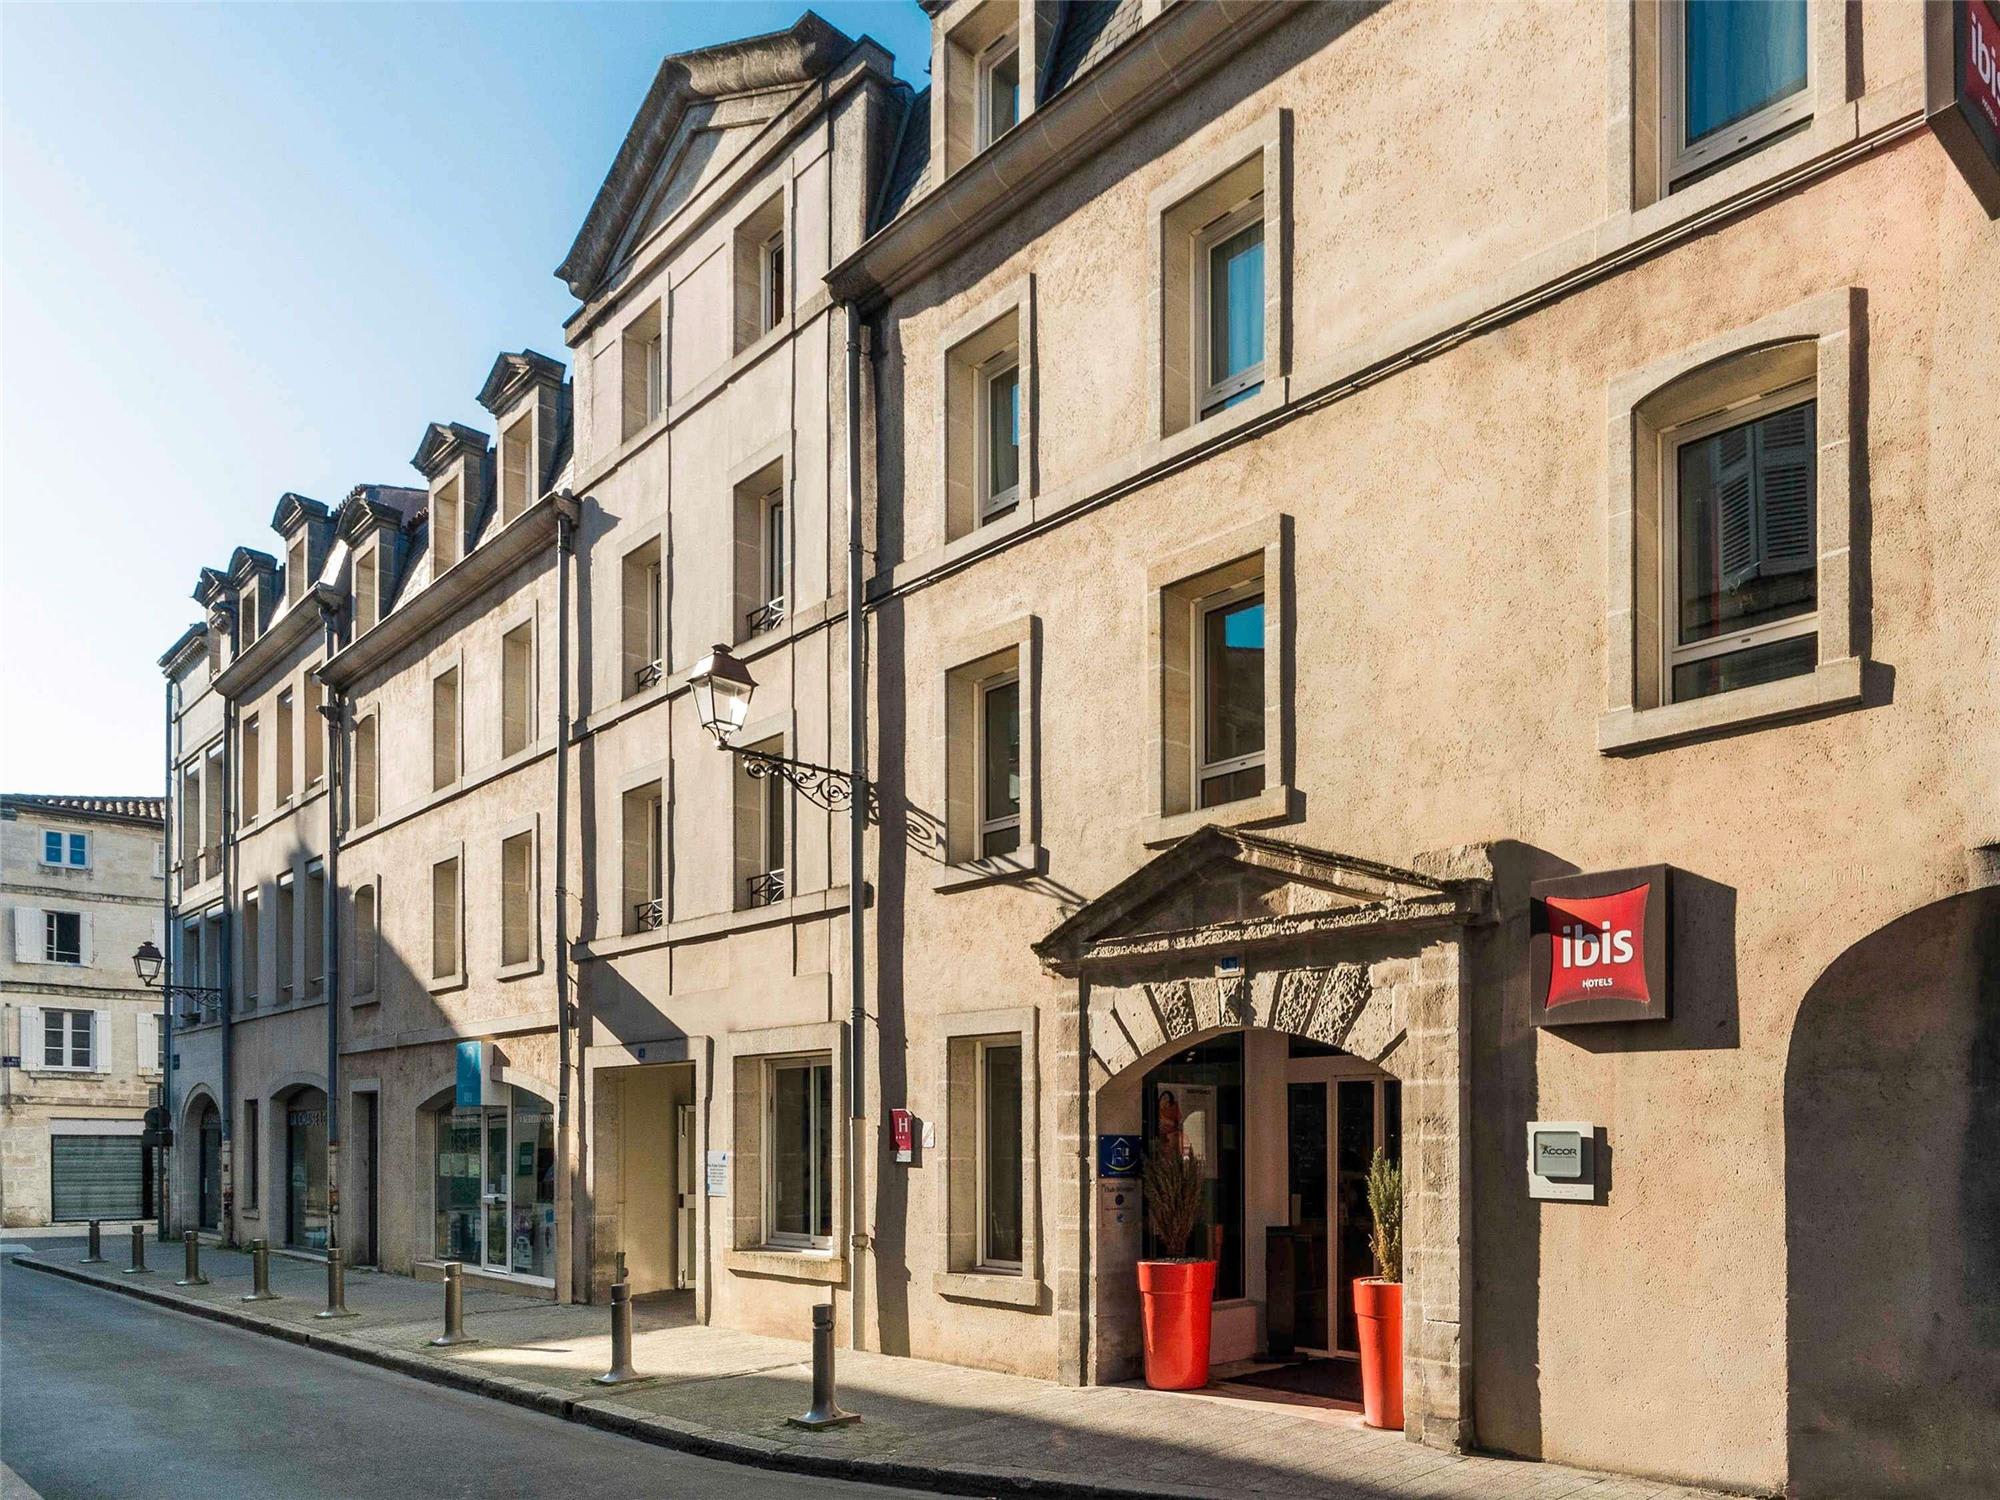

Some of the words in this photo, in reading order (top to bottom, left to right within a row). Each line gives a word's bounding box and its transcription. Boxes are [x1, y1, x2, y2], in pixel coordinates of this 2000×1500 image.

[1562, 921, 1634, 969] ibis
[1582, 978, 1613, 989] HOTELS
[898, 1117, 909, 1133] H
[1541, 1145, 1578, 1156] ACCOR
